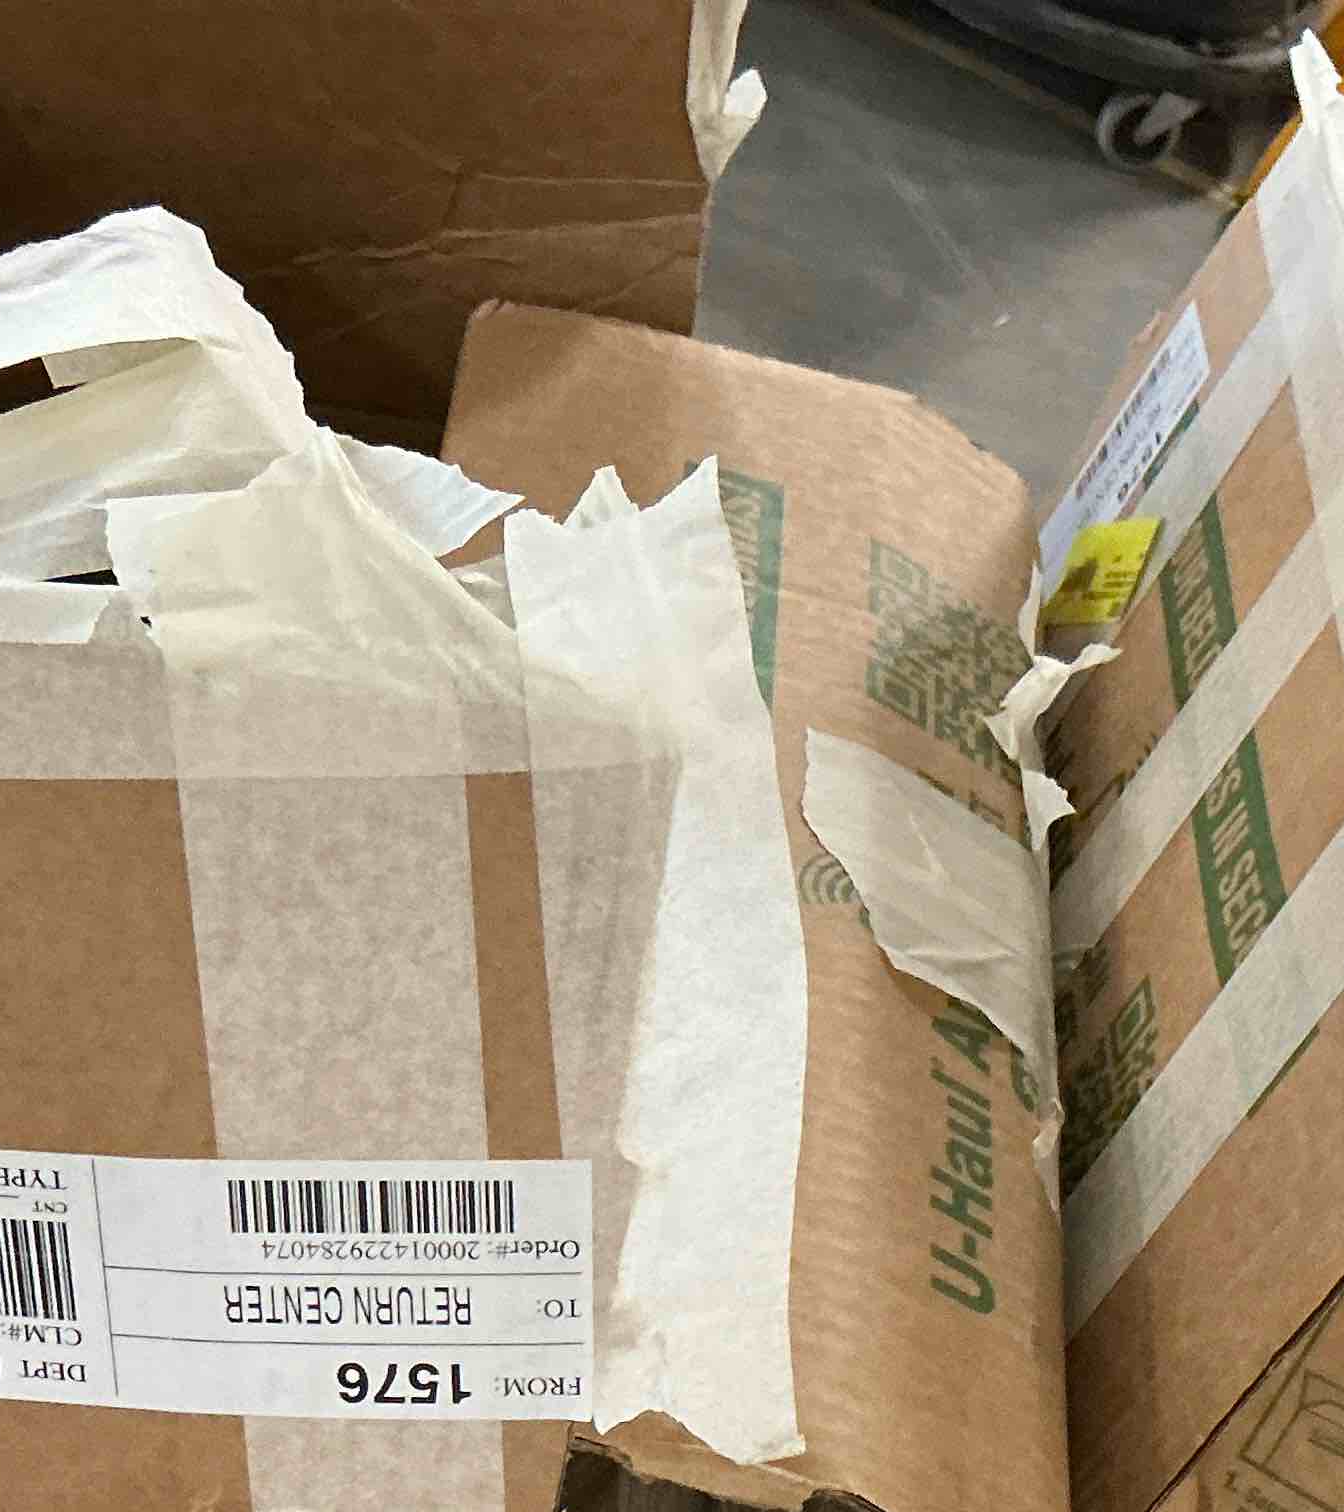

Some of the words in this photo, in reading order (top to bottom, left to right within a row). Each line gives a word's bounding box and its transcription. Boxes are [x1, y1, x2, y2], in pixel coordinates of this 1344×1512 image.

[31, 1200, 67, 1214] CNT
[262, 1238, 481, 1262] 200014229284074
[489, 1238, 582, 1261] Order#:
[225, 1285, 344, 1323] CENTER
[351, 1285, 472, 1324] RETURN
[536, 1298, 581, 1319] TO:
[16, 1357, 87, 1383] DEPT
[338, 1362, 471, 1405] 1576
[493, 1374, 583, 1397] FROM:
